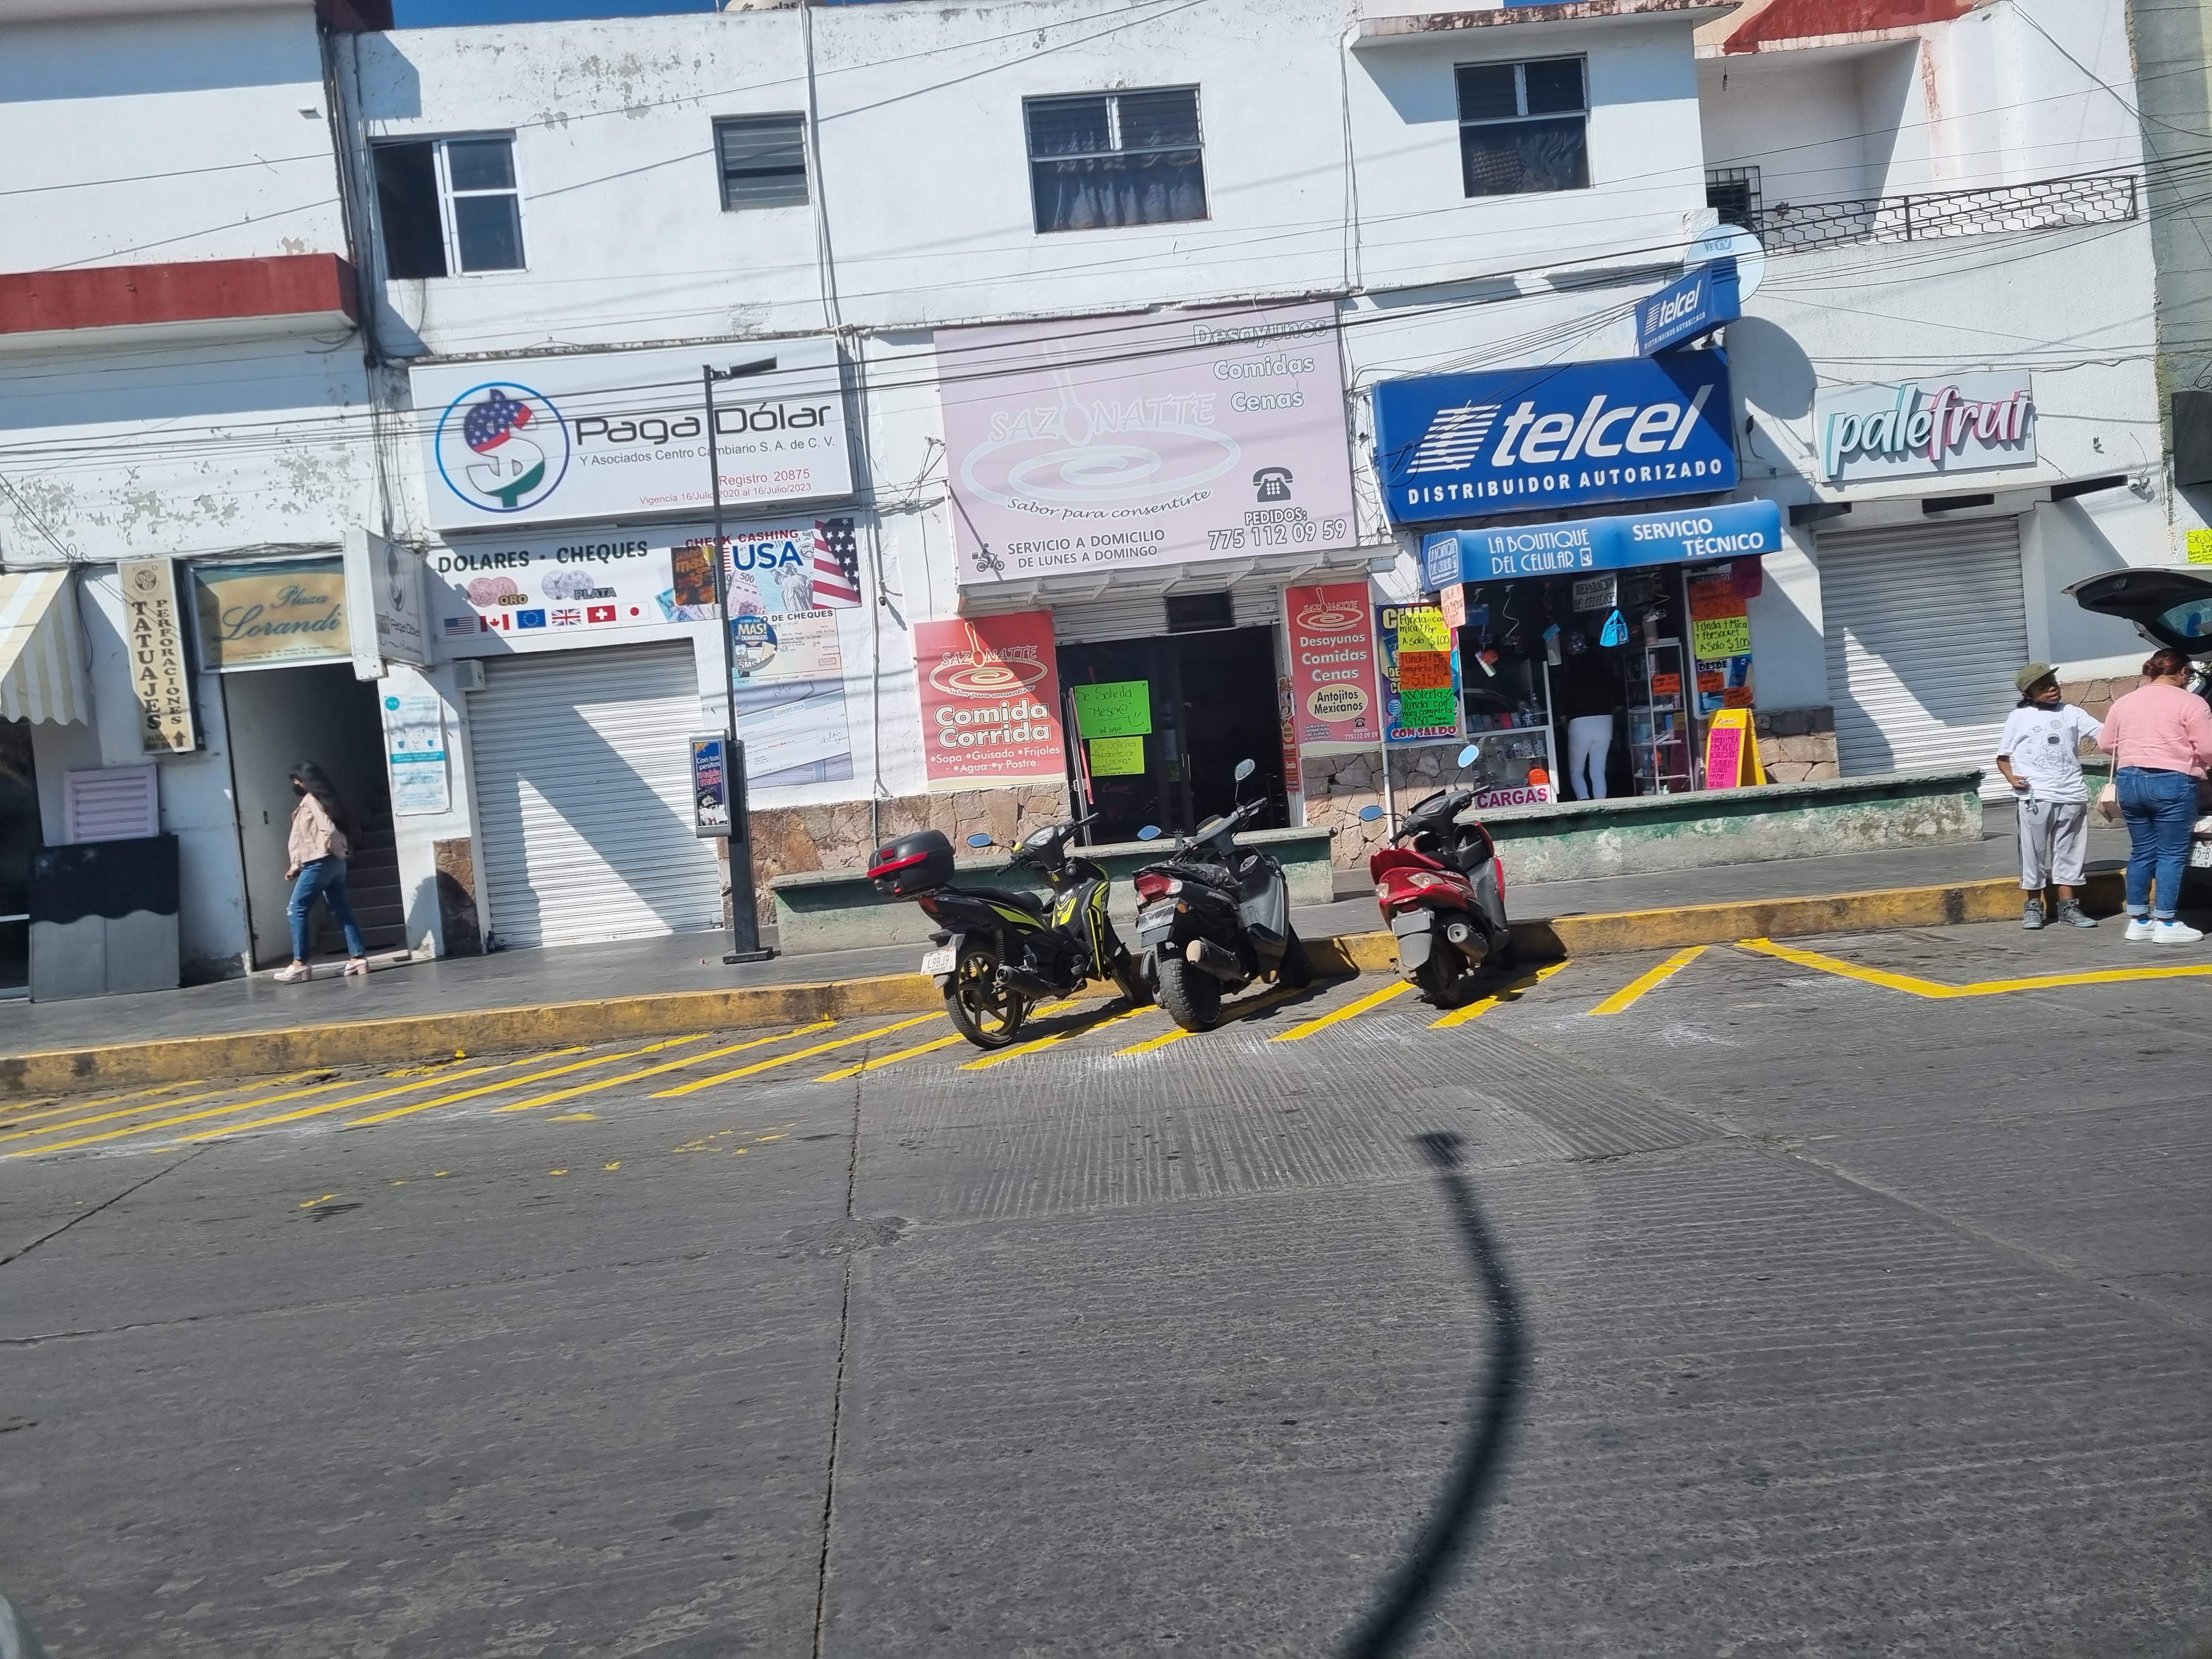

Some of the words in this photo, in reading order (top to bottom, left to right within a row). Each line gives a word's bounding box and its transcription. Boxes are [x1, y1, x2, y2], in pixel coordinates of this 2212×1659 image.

[1658, 279, 1702, 328] telcel
[1193, 320, 1327, 348] Desayunos
[1644, 325, 1675, 349] DISTRIBUIDOR
[1676, 312, 1706, 333] AUTORIZADO
[1213, 354, 1315, 380] Comidas
[1231, 391, 1304, 412] Cenas
[575, 416, 701, 446] Paga
[714, 402, 831, 435] Dólar
[1492, 384, 1714, 466] telcel
[1827, 382, 2032, 477] palefrut
[580, 456, 588, 466] Y
[591, 453, 652, 465] Asociados
[655, 449, 694, 460] Centro
[697, 442, 756, 457] Cambiario
[760, 442, 771, 452] S.
[775, 441, 786, 451] A.
[791, 439, 804, 449] de
[808, 437, 820, 448] C.
[823, 436, 835, 447] V.
[719, 474, 768, 488] Registro
[774, 469, 810, 482] 20875
[1408, 474, 1571, 504] DISTRIBUIDOR
[1579, 459, 1722, 488] AUTORIZADO
[640, 495, 678, 506] Vigencia
[743, 488, 751, 496] al
[754, 483, 811, 495] 16/Julio/2023
[1007, 498, 1059, 515] Sabor
[1062, 507, 1108, 520] para
[1111, 490, 1211, 518] consentirte
[1244, 507, 1307, 526] PEDIDOS:
[738, 529, 799, 543] CASHING
[1208, 528, 1245, 550] 775
[1251, 524, 1287, 546] 112
[1292, 521, 1317, 543] 09
[1323, 519, 1346, 540] 59
[1488, 537, 1505, 554] LA
[1506, 529, 1590, 552] BOUTIQUE
[1633, 518, 1713, 542] SERVICIO
[1007, 538, 1070, 555] SERVICIO
[1075, 537, 1086, 549] A
[1091, 529, 1165, 547] DOMICILIO
[1681, 532, 1763, 556] TÉCNICO
[439, 550, 530, 573] DOLARES
[556, 540, 648, 564] CHEQUES
[732, 541, 804, 571] USA
[1018, 558, 1034, 568] DE
[1039, 553, 1077, 566] LUNES
[1081, 552, 1090, 562] A
[1095, 545, 1158, 561] DOMINGO
[1492, 556, 1517, 574] DEL
[1521, 551, 1574, 571] CELULAR
[739, 572, 755, 583] 500
[270, 585, 329, 608] Plaza
[498, 594, 528, 606] ORO
[574, 587, 617, 601] PLATA
[772, 614, 783, 622] DE
[787, 610, 834, 620] CHEQUES
[738, 623, 767, 636] MÁS!
[1300, 633, 1365, 648] Desayunos
[1727, 637, 1750, 652] $100
[131, 601, 161, 730] TATUAJES
[156, 600, 182, 724] PERFORACIONES
[1302, 648, 1367, 665] Comidas
[1698, 660, 1728, 672] DESDE
[1312, 668, 1359, 682] Cenas
[948, 688, 970, 697] Sabor
[1075, 687, 1090, 702] Se
[1096, 685, 1132, 701] Solicita
[1317, 690, 1358, 704] Antojitos
[935, 699, 1048, 727] Comida
[1314, 701, 1363, 715] Mexicanos
[939, 721, 1051, 748] Corrida
[1392, 728, 1417, 739] CON
[1417, 726, 1457, 738] SALDO
[699, 761, 721, 771] pesitos
[1476, 788, 1548, 808] CARGAS
